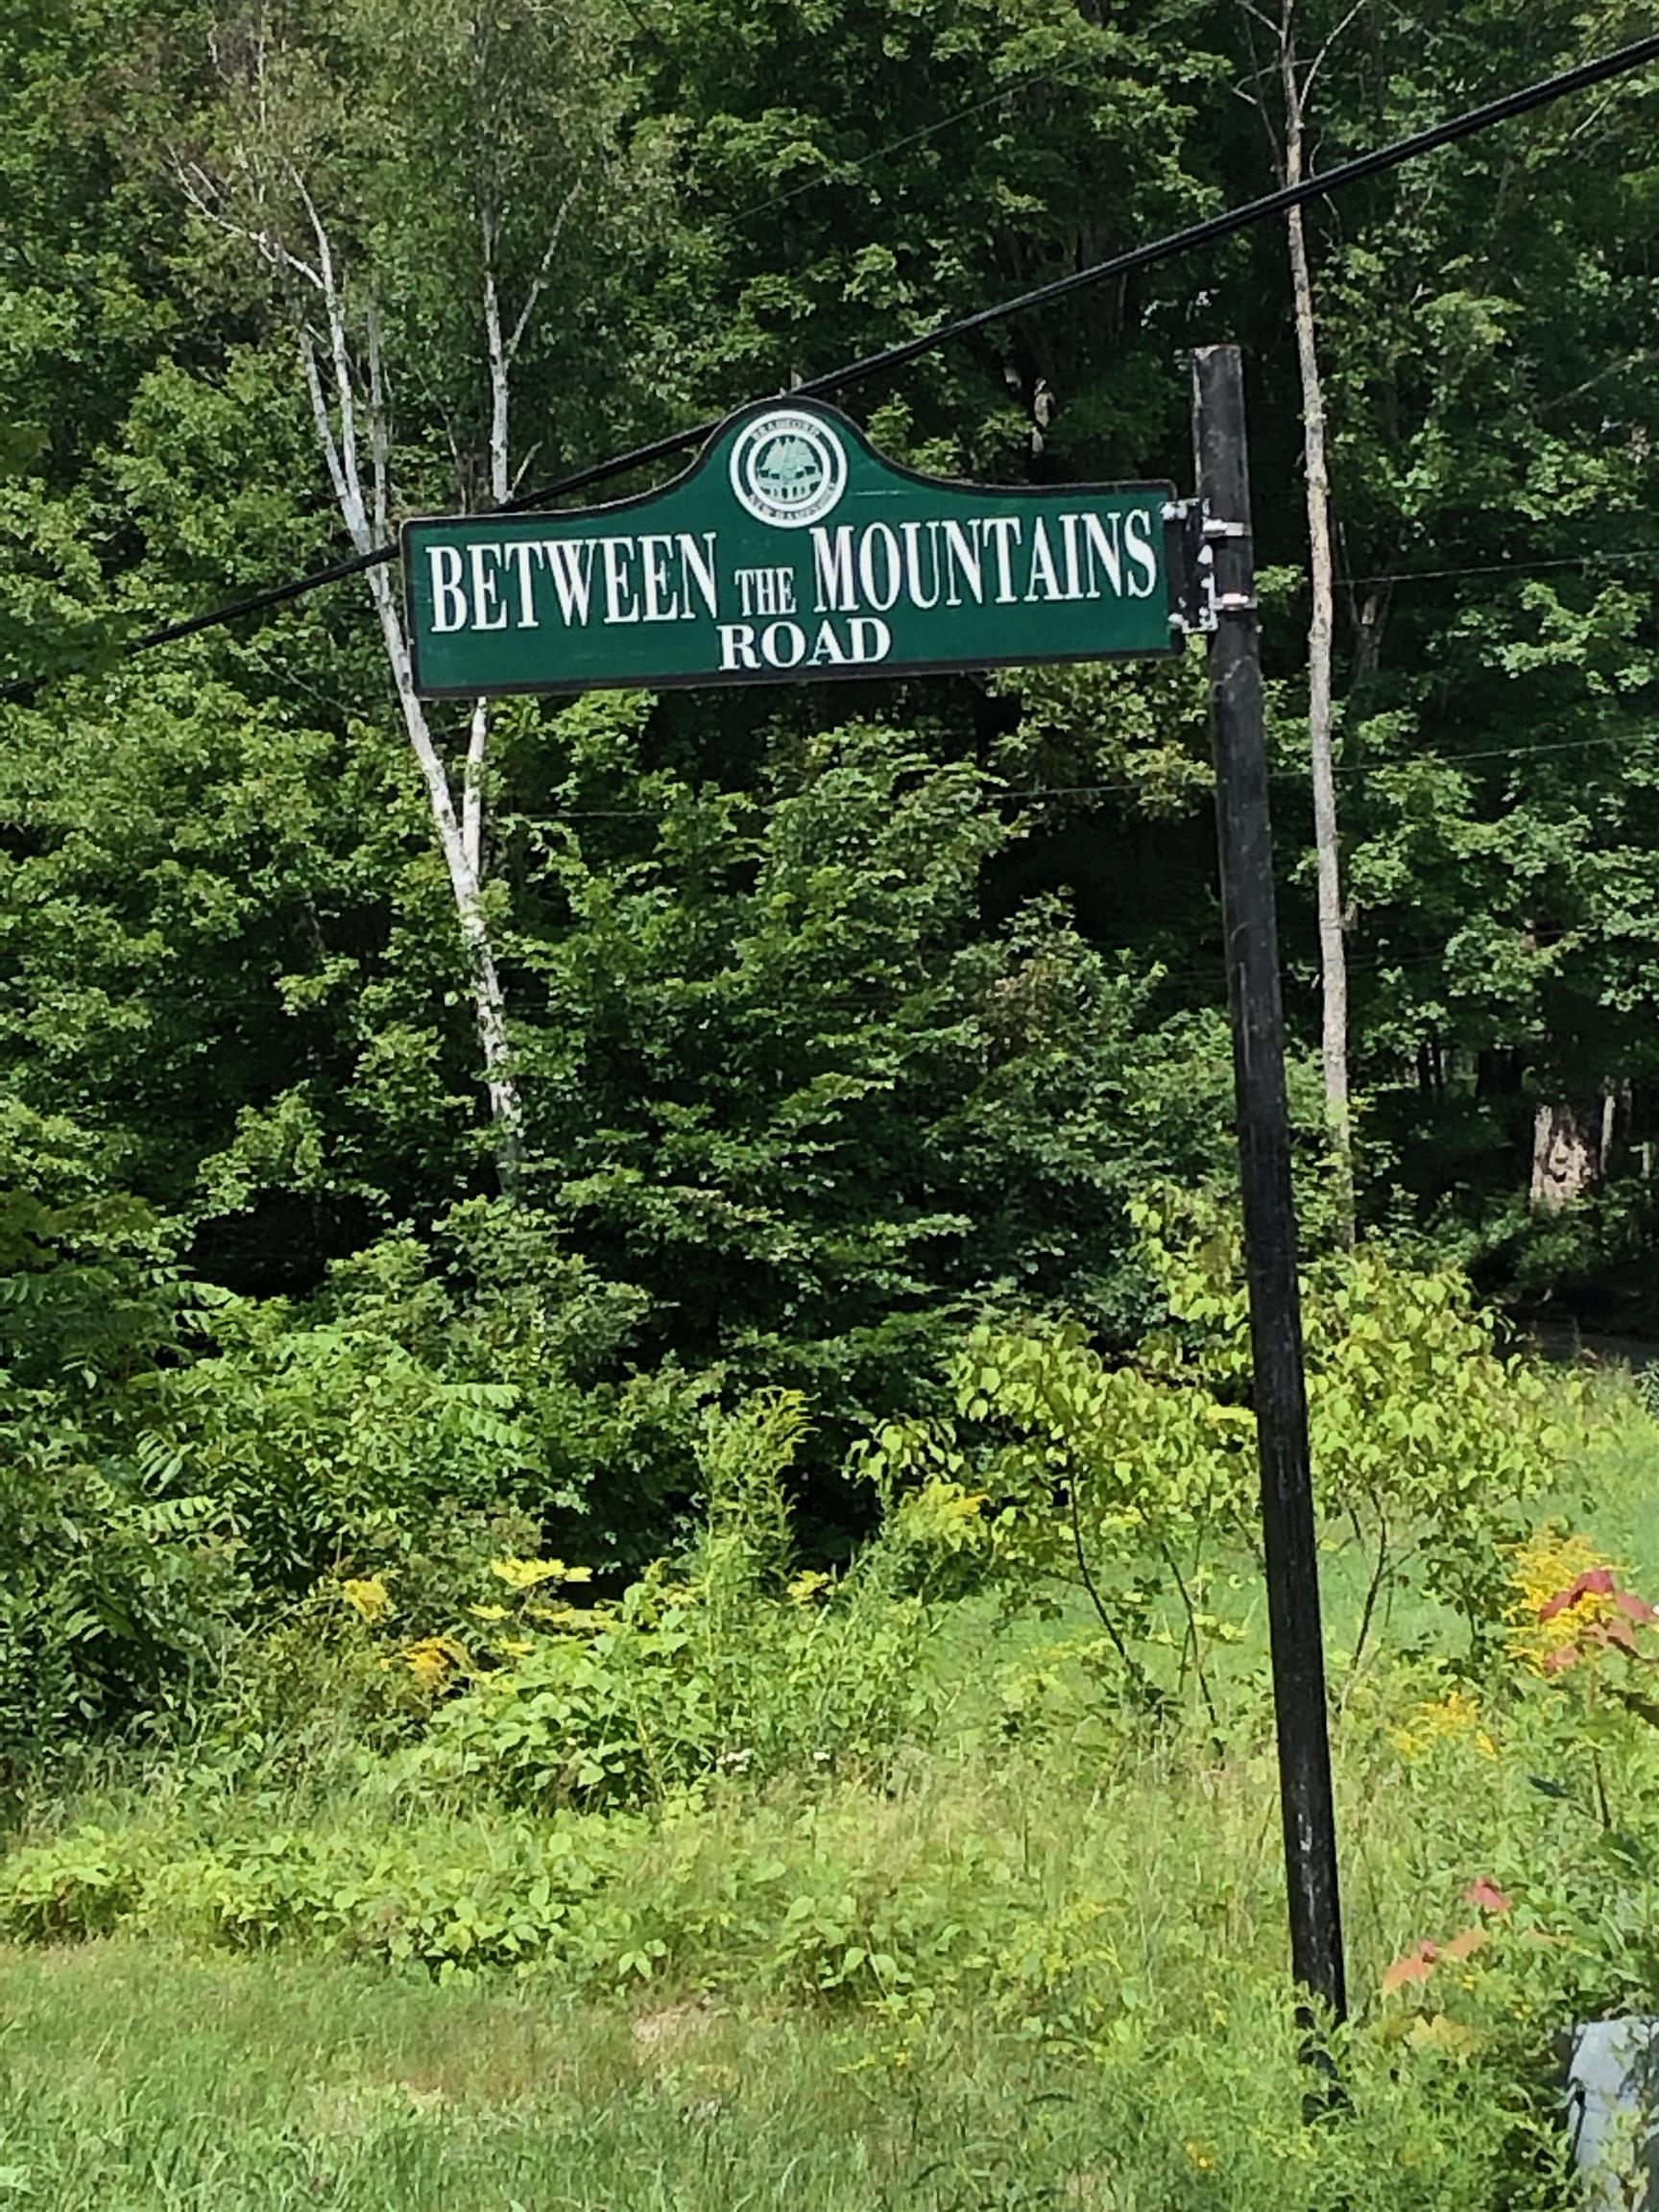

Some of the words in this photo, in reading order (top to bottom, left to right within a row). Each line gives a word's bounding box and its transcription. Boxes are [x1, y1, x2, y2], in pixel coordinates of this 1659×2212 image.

[424, 531, 719, 634] BETWEEN
[735, 567, 797, 617] THE
[809, 509, 1158, 613] MOUNTAINS
[716, 617, 891, 671] ROAD
